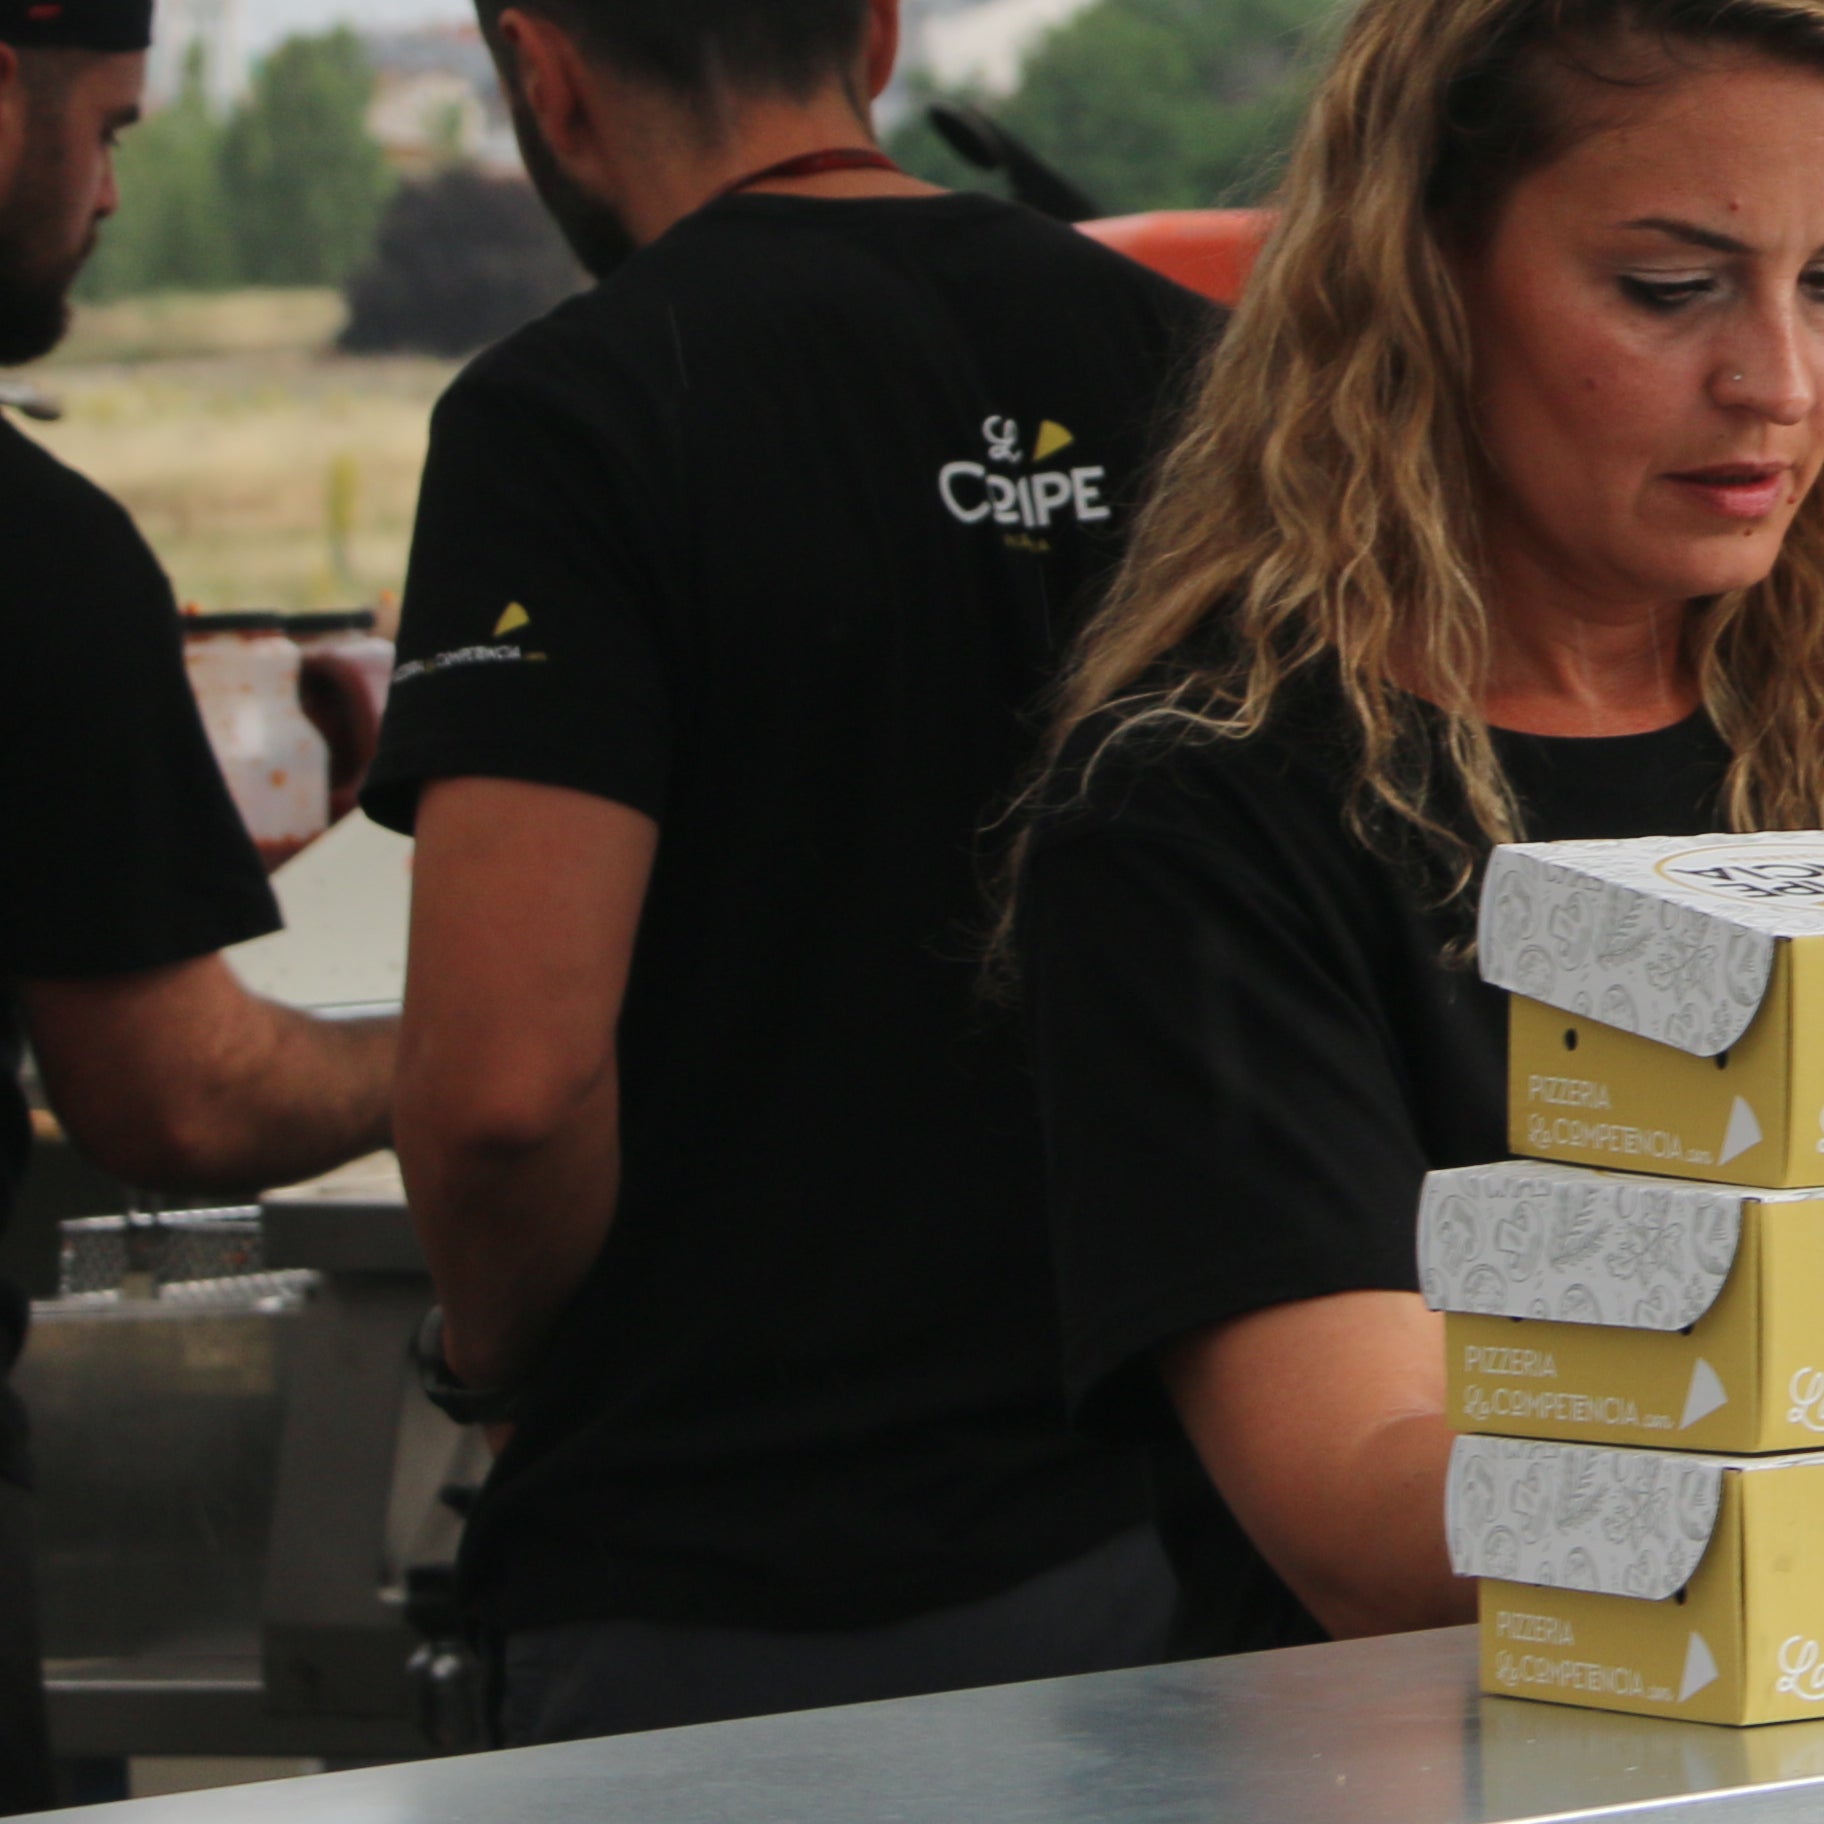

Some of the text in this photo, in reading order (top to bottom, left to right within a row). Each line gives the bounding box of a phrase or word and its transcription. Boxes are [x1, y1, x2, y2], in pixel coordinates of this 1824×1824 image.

[1528, 1075, 1612, 1109] PIZZERIA
[1464, 1346, 1557, 1377] PIZZERIA
[1497, 1611, 1575, 1645] PIZZERIA
